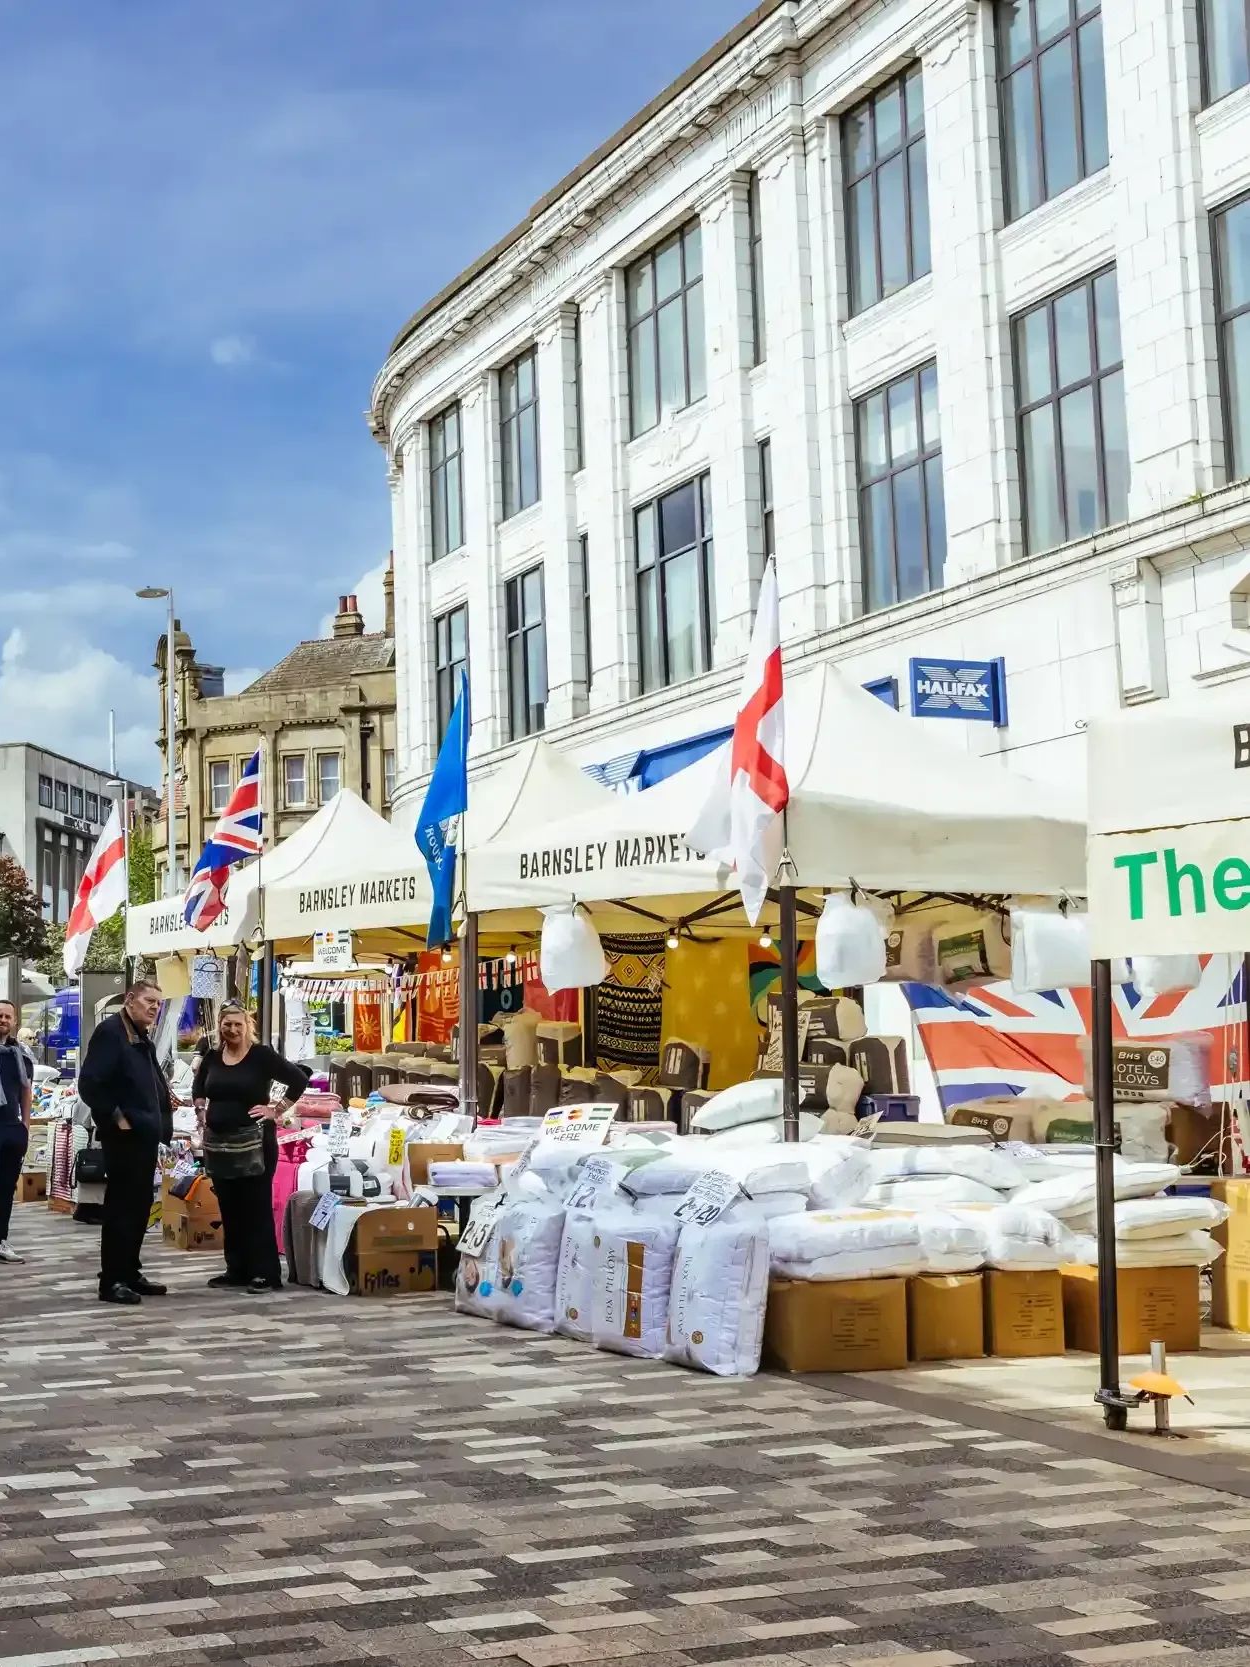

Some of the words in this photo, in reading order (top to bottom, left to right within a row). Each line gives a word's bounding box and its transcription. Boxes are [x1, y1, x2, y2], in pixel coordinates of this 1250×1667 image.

[917, 679, 990, 698] HALIFAX
[520, 841, 607, 880] BARNSLEY
[299, 883, 356, 913] BARNSLEY
[359, 876, 416, 906] MARKETS
[150, 911, 187, 935] BARNSLE
[318, 945, 347, 956] WELCOME
[323, 955, 338, 964] HERE
[1118, 1051, 1141, 1060] BHS
[545, 1123, 601, 1135] WELCOME
[553, 1132, 581, 1141] HERE
